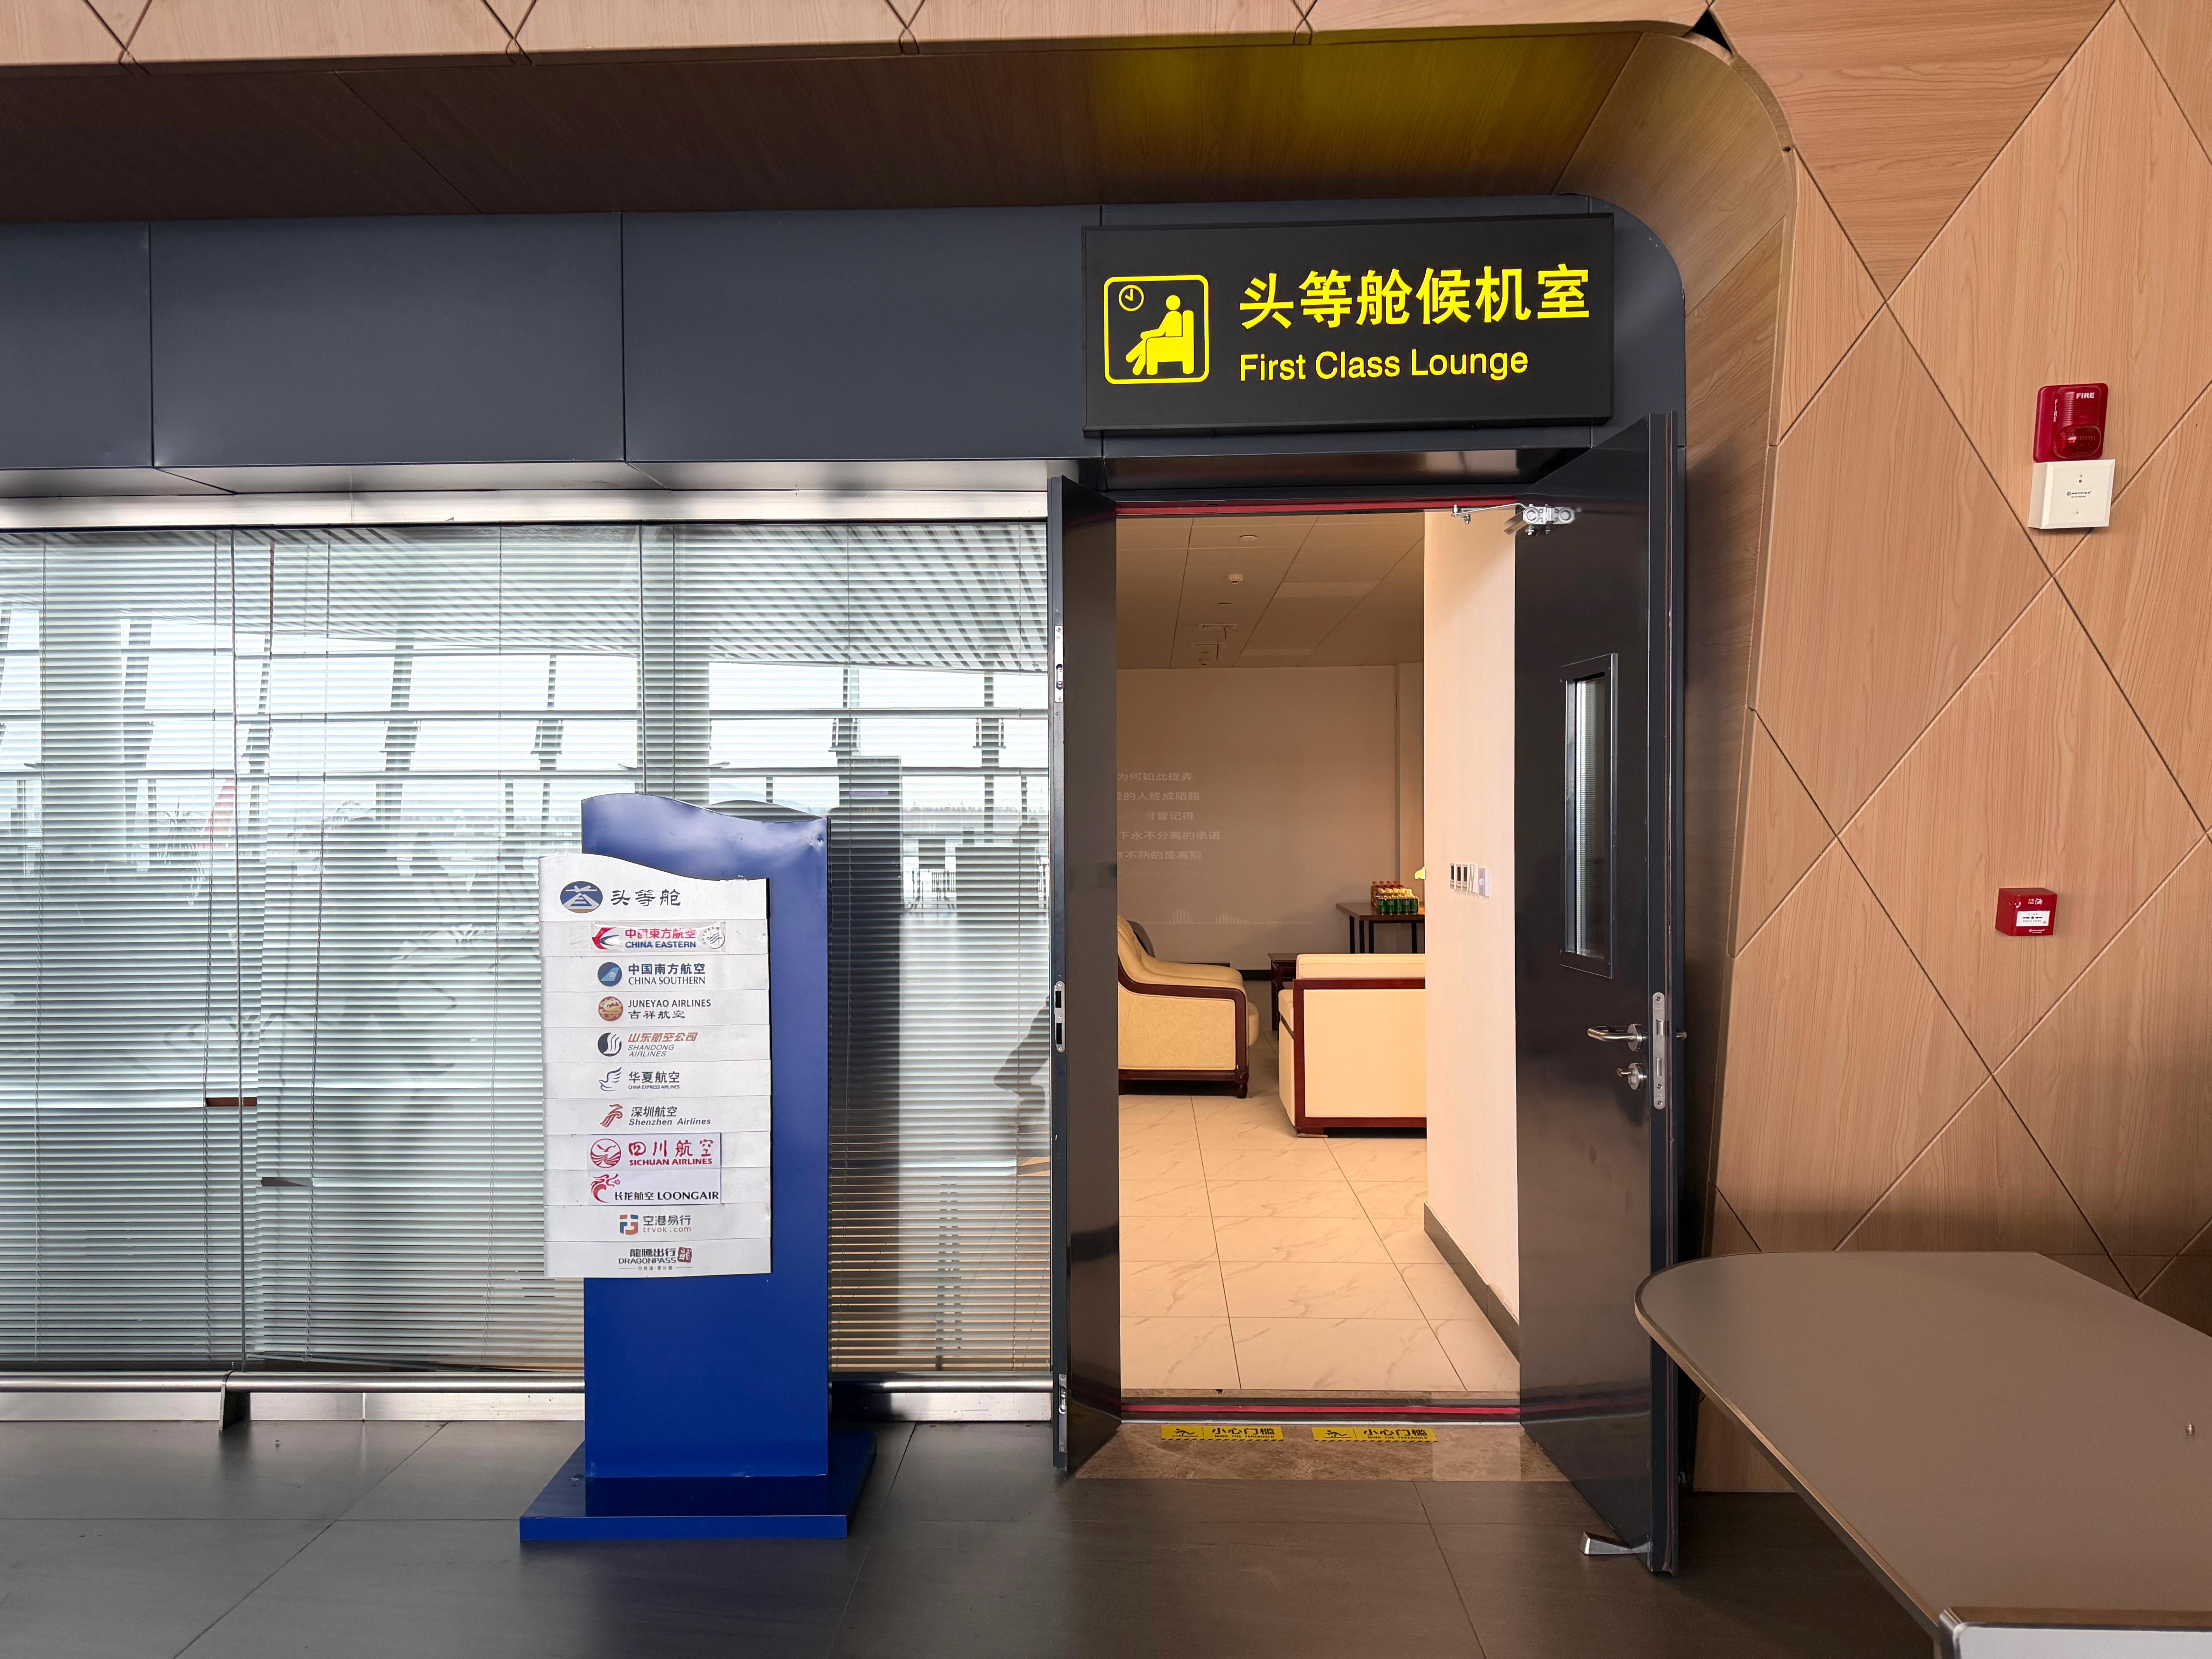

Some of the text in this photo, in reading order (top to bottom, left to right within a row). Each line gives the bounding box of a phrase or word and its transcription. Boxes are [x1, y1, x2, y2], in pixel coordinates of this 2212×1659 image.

[1239, 263, 1590, 330] 头等舱候机室
[1241, 349, 1528, 381] First Class Lounge
[610, 889, 681, 907] 头等舱
[628, 963, 706, 975] 中国南方航空
[628, 976, 706, 985] CHINA SOUTHERN
[628, 999, 711, 1008] JUNEYAO AIRLINES
[628, 1010, 685, 1019] 吉祥航空
[627, 1032, 698, 1042] 山东航空公司
[629, 1071, 680, 1084] 华夏航空
[630, 1106, 678, 1118] 深圳航空
[628, 1139, 713, 1158] 四川航空
[614, 1192, 654, 1200] 长龙航空
[657, 1191, 719, 1200] LOONGAIR
[643, 1215, 691, 1226] 空港易行
